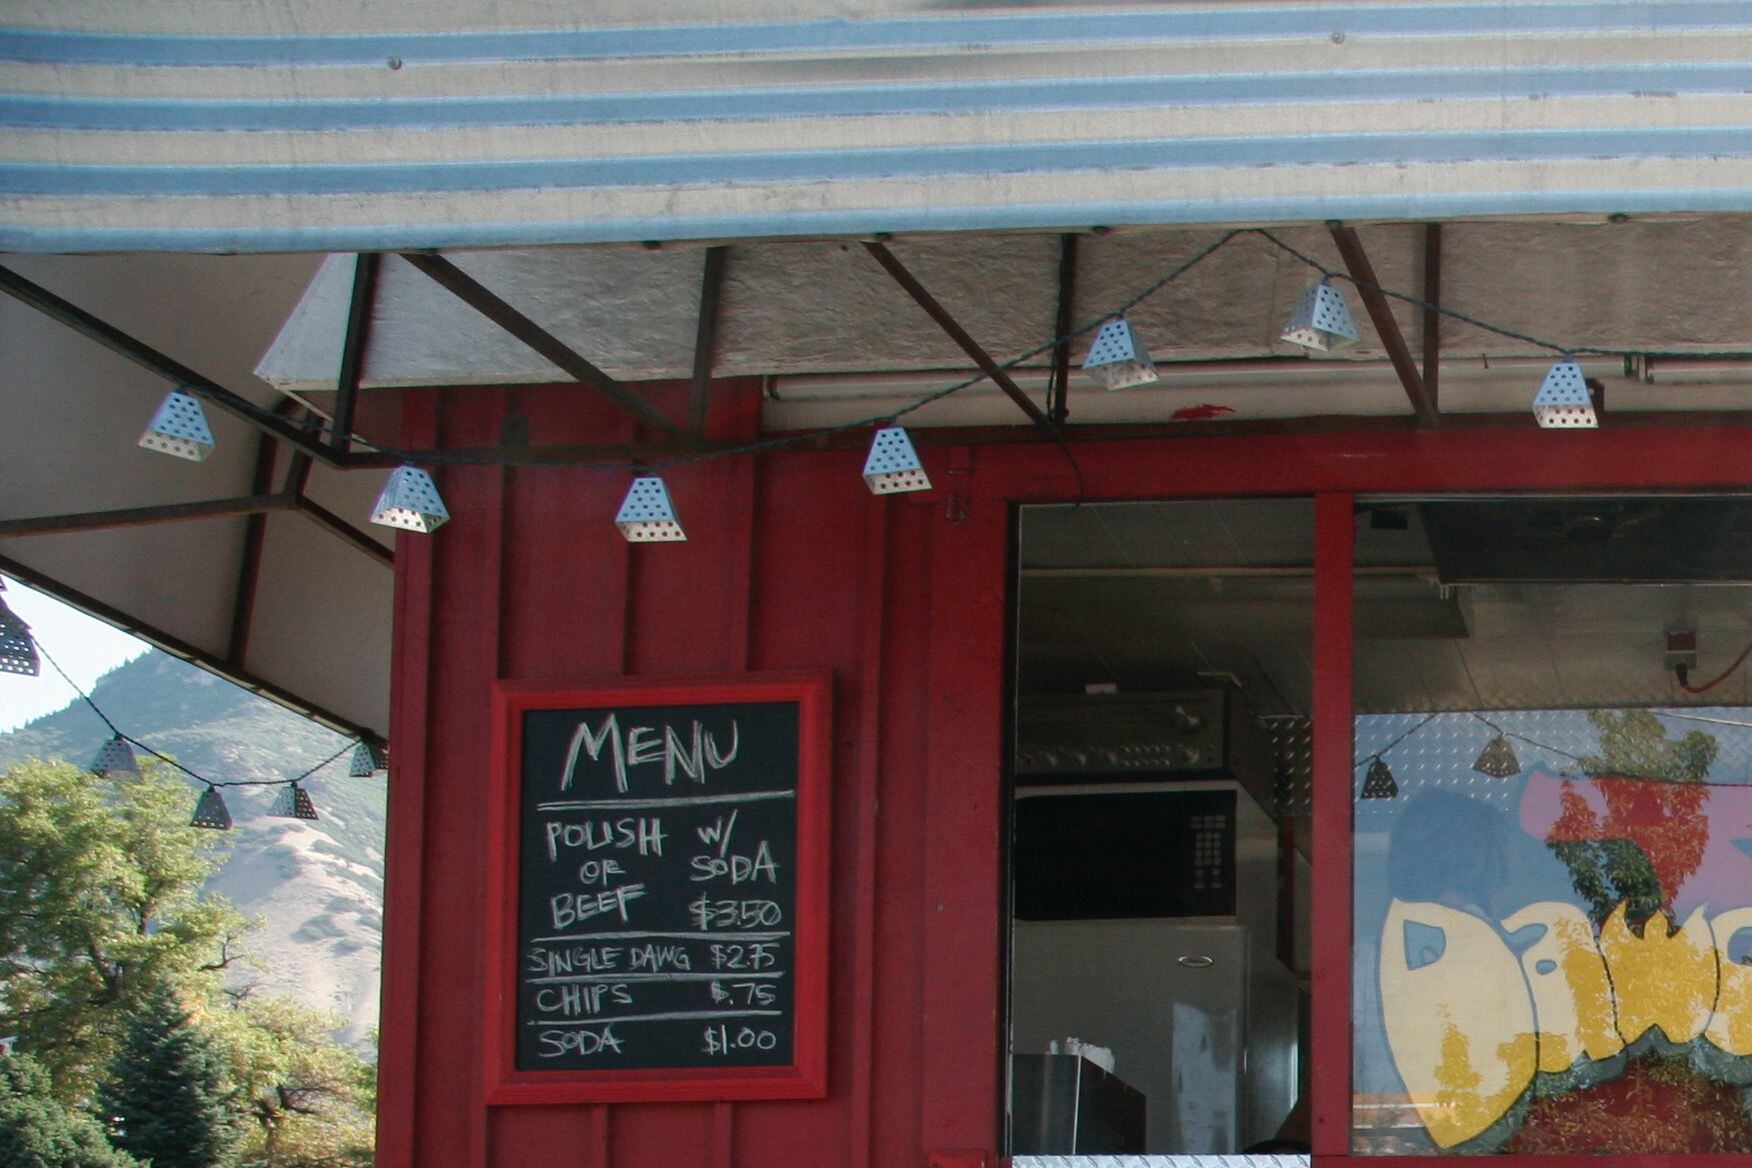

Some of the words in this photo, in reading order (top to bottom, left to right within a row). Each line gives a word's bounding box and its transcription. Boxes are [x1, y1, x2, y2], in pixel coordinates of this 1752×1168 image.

[561, 713, 739, 793] MENU
[546, 817, 668, 862] POLISH
[689, 840, 779, 884] SODA
[551, 883, 647, 930] BEEF
[689, 891, 781, 930] $3.50
[526, 947, 624, 976] SINGLE
[629, 944, 690, 973] DAWG
[711, 943, 780, 970] $2.75
[537, 983, 632, 1015] CHIPS
[711, 980, 776, 1005] $.75
[538, 1024, 625, 1058] SODA
[702, 1024, 776, 1055] $1.00
